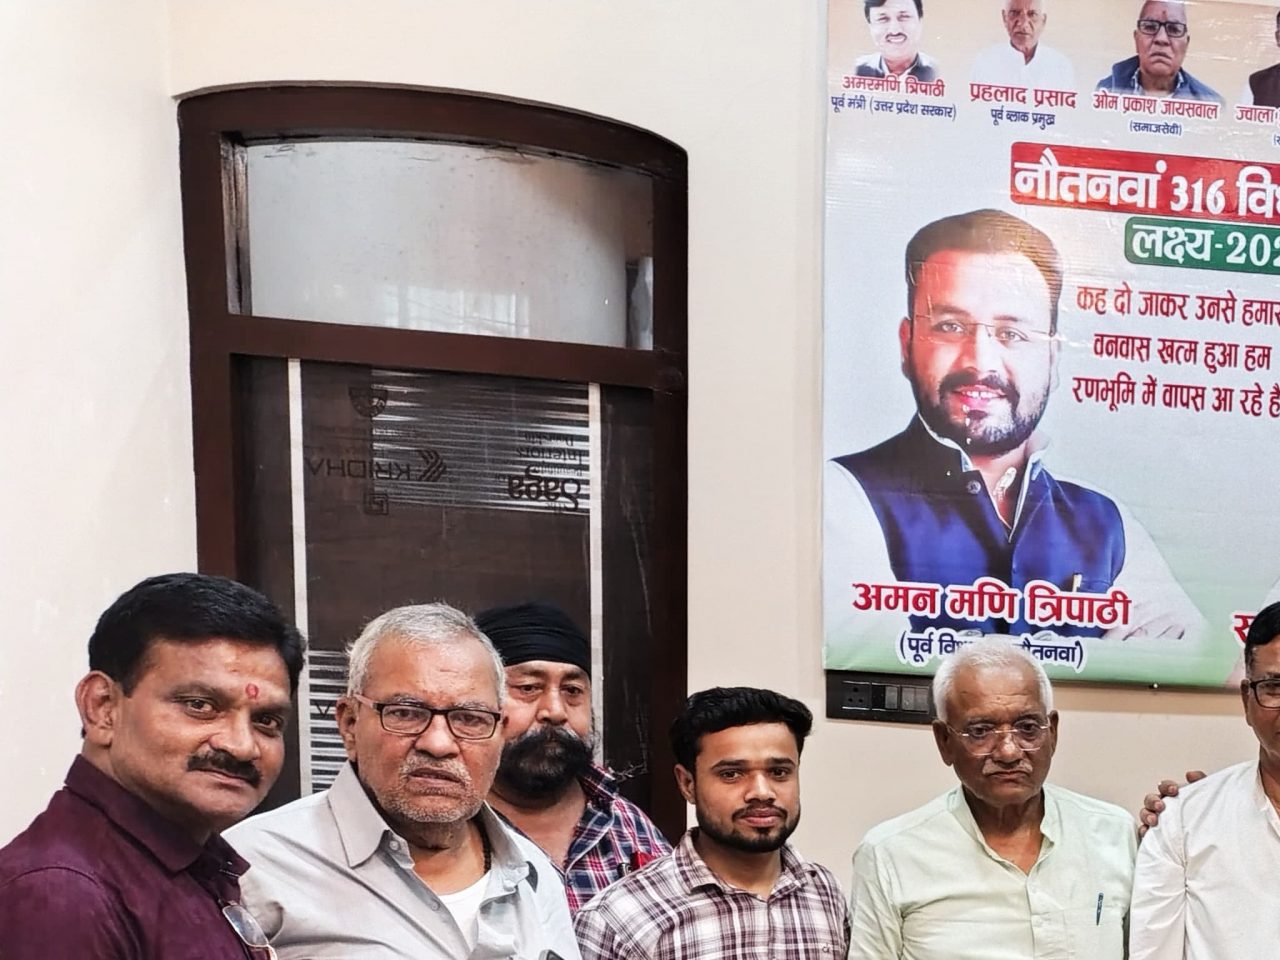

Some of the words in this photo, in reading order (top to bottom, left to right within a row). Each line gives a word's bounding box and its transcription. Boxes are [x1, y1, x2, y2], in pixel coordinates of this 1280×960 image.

[842, 75, 900, 93] अमरमणि
[905, 76, 945, 97] त्रिपाठी
[969, 82, 1027, 105] प्रहलाद
[1033, 88, 1077, 109] प्रसाद
[830, 94, 846, 114] पूर्व
[895, 100, 919, 116] प्रदेश
[920, 103, 957, 122] सरकार)
[990, 105, 1004, 126] पूर्व
[1031, 112, 1056, 130] प्रमुख
[1093, 90, 1118, 110] ओम
[1122, 96, 1157, 115] प्रकाश
[1160, 100, 1218, 120] जायसवाल
[1236, 105, 1275, 124] ज्वाला
[1129, 118, 1183, 136] (समाजसेवी)
[1012, 147, 1168, 209] नौतनवां
[1170, 177, 1226, 216] 316
[1076, 285, 1108, 315] कह
[1114, 281, 1132, 317] दो
[1138, 290, 1190, 321] जाकर
[1195, 289, 1238, 325] उनसे
[1093, 333, 1152, 363] वनवास
[1157, 337, 1199, 366] खत्म
[1204, 341, 1240, 374] हुआ
[1244, 343, 1272, 373] हम
[1072, 371, 1137, 412] रणभूमि
[1142, 374, 1159, 408] में
[1161, 383, 1207, 413] वापस
[1212, 387, 1235, 414] आ
[1240, 382, 1264, 417] रहे
[303, 457, 411, 481] KRIDHA
[852, 582, 939, 615] अमन
[948, 581, 1018, 620] मणि
[1028, 584, 1133, 626] त्रिपाठी
[899, 629, 933, 662] (पूर्व
